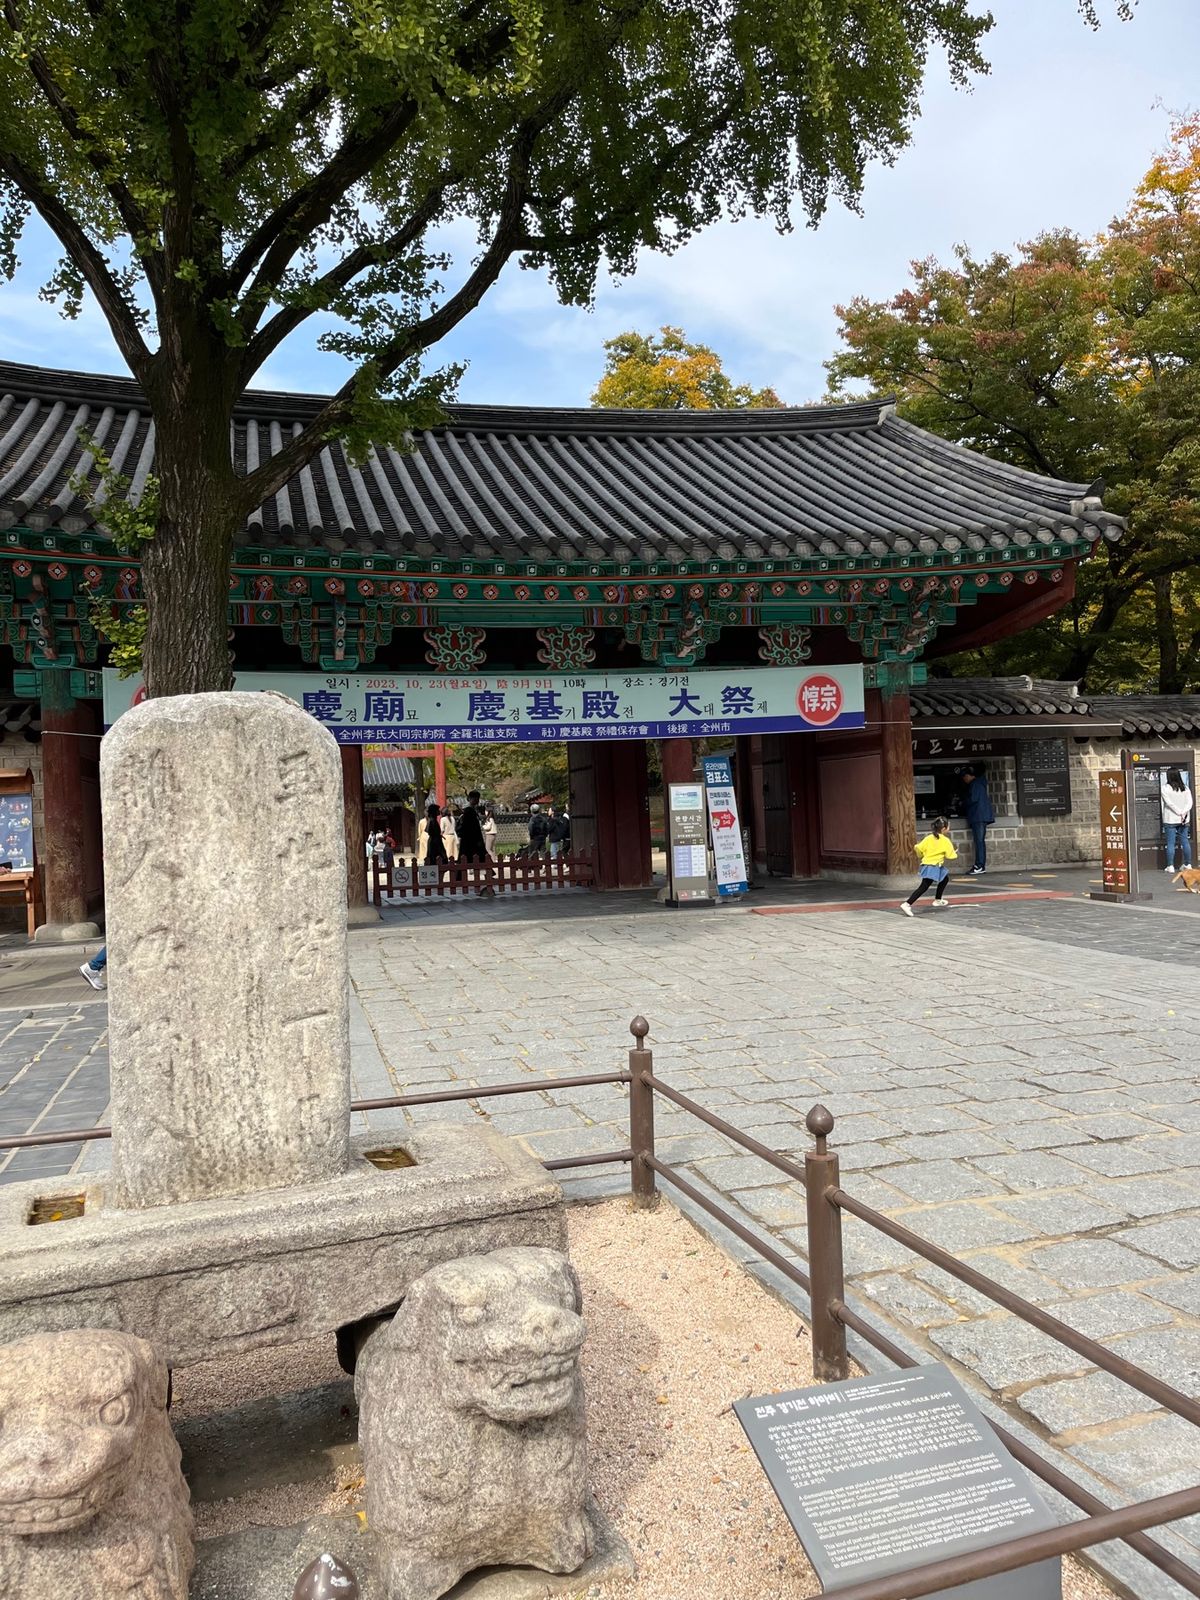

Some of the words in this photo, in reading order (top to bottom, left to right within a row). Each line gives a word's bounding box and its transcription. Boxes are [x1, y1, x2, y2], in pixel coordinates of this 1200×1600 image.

[326, 678, 350, 689] 일시
[366, 679, 399, 690] 2023.
[406, 679, 423, 690] 10.
[512, 680, 530, 689] 9月
[535, 680, 552, 689] 9日
[563, 679, 586, 689] 10時
[622, 678, 644, 687] 장소
[659, 676, 689, 687] 경기전
[667, 724, 689, 734] 後援
[700, 722, 731, 733] 全州市
[706, 771, 730, 784] 검표소
[755, 1407, 776, 1419] 전주
[776, 1400, 809, 1414] 경기전
